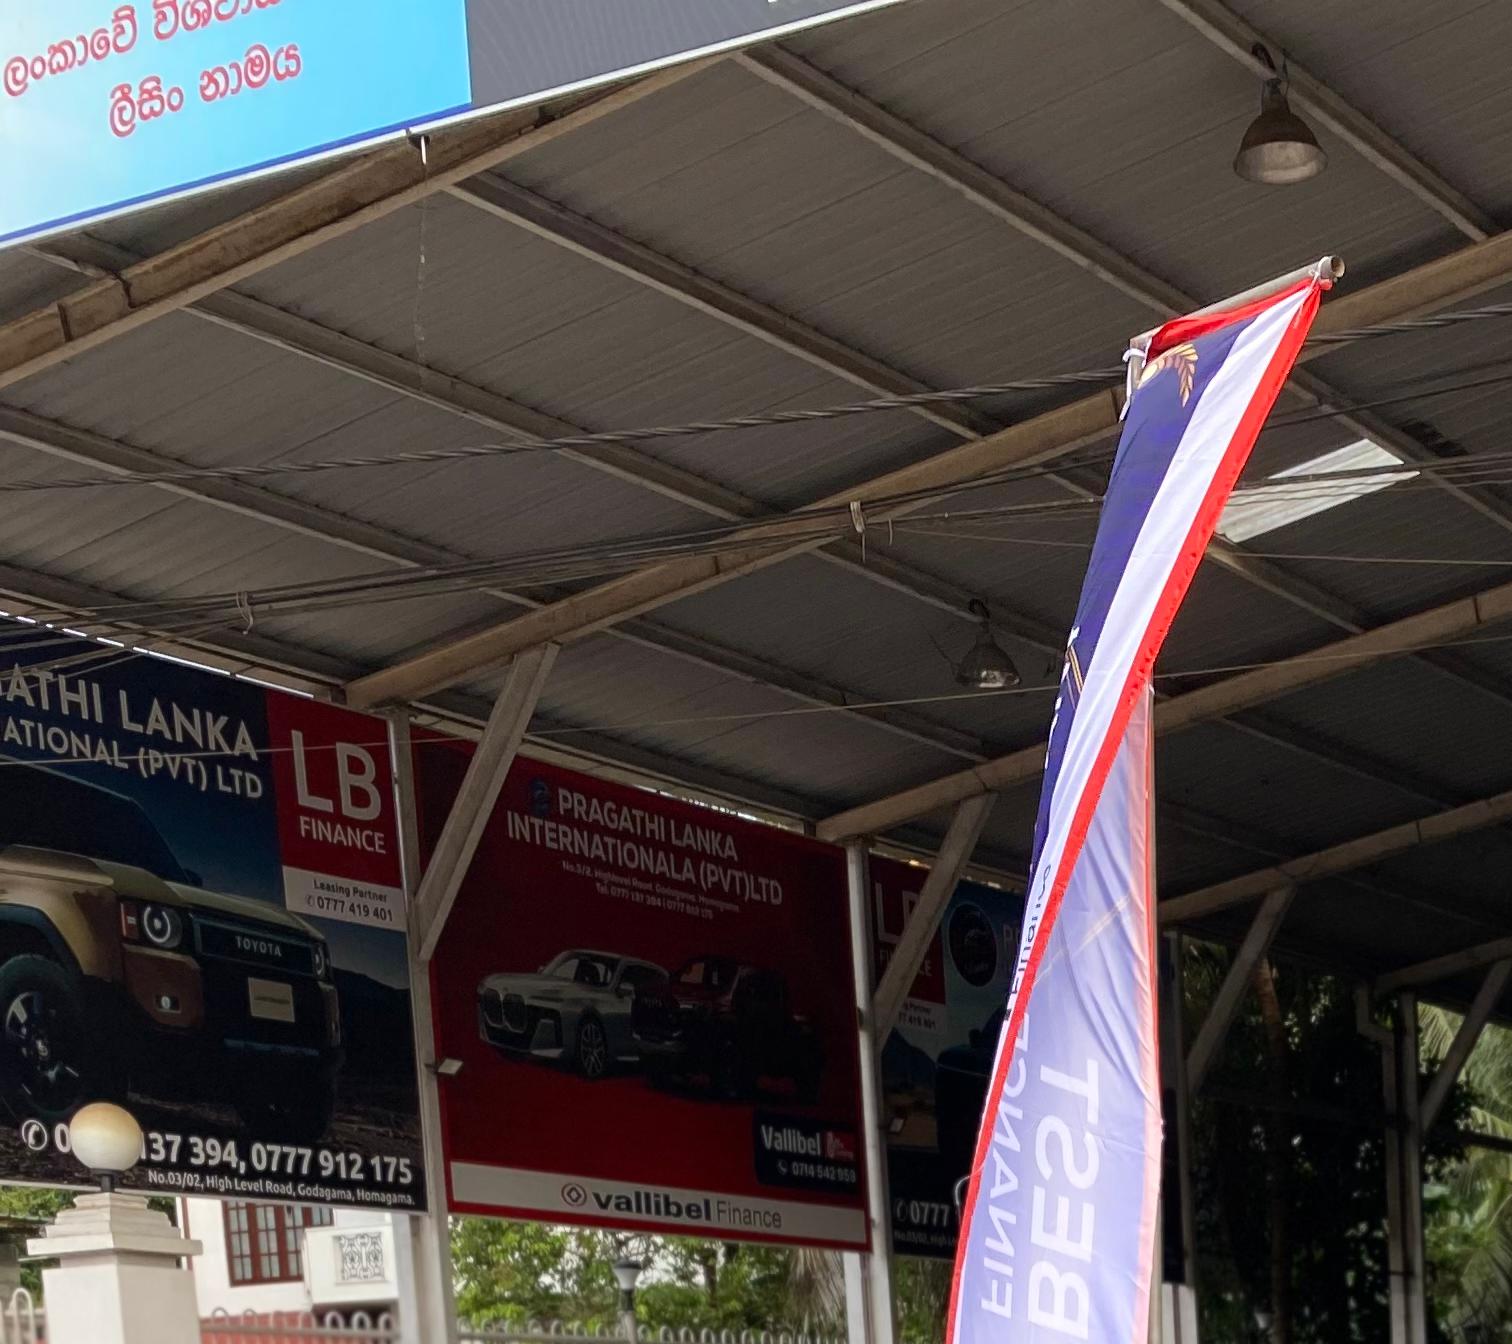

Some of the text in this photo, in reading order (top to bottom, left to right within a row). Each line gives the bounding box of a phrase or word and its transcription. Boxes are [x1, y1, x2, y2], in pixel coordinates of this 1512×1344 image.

[199, 43, 302, 102] නාමය
[0, 662, 259, 762] ATHI LANKA
[3, 716, 263, 799] ATIONAL (PVT) LTD
[290, 729, 382, 822] LB
[299, 815, 387, 855] FINANCE
[557, 787, 739, 862] PRAGATHI LANKA
[506, 810, 696, 885] INTERNATIONALA
[313, 878, 389, 903] Leasing Partner
[316, 895, 394, 923] 0777 419 401
[234, 934, 283, 958] TOYOTA
[189, 1136, 247, 1174] 394,
[251, 1142, 312, 1175] 0777
[318, 1149, 364, 1181] 912
[370, 1156, 413, 1184] 175
[760, 1124, 822, 1156] Vallibel
[147, 1169, 205, 1190] No.03/02,
[206, 1174, 233, 1193] High
[234, 1178, 264, 1195] Level
[265, 1181, 297, 1197] Road,
[591, 1190, 783, 1229] vallibel Finance
[909, 1199, 950, 1228] 0777
